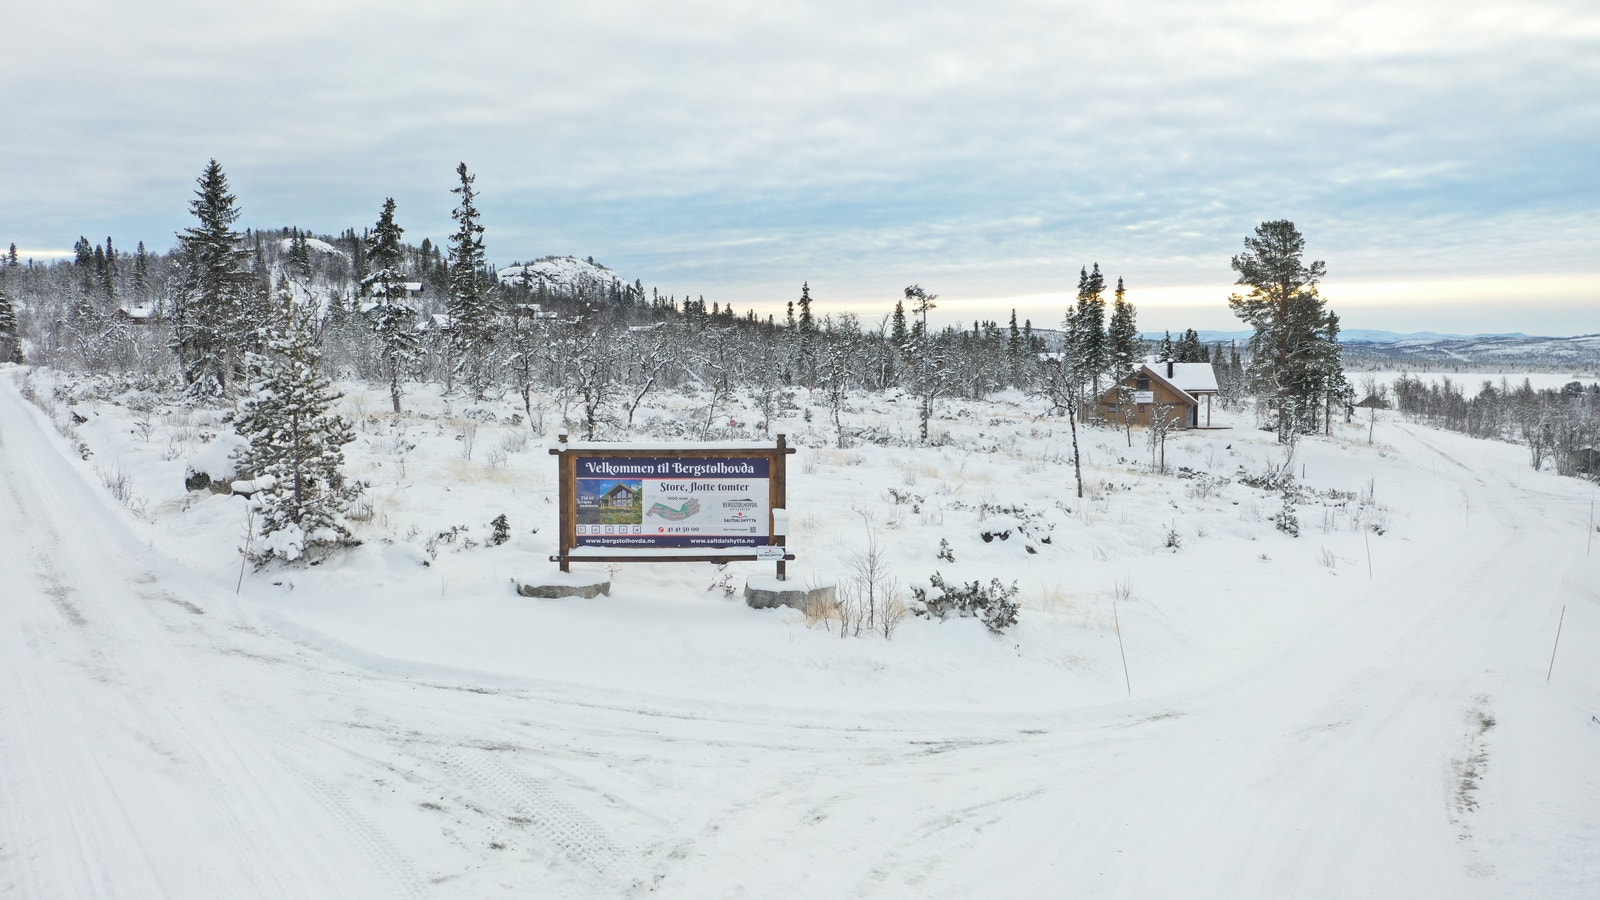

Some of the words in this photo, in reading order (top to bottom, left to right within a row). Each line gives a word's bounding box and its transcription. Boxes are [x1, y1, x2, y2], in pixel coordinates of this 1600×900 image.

[585, 461, 655, 475] Velkommen
[657, 462, 669, 474] til
[671, 462, 755, 476] Bergstølhovda
[660, 482, 688, 492] Store,
[689, 482, 716, 493] flotte
[717, 483, 750, 492] tomter
